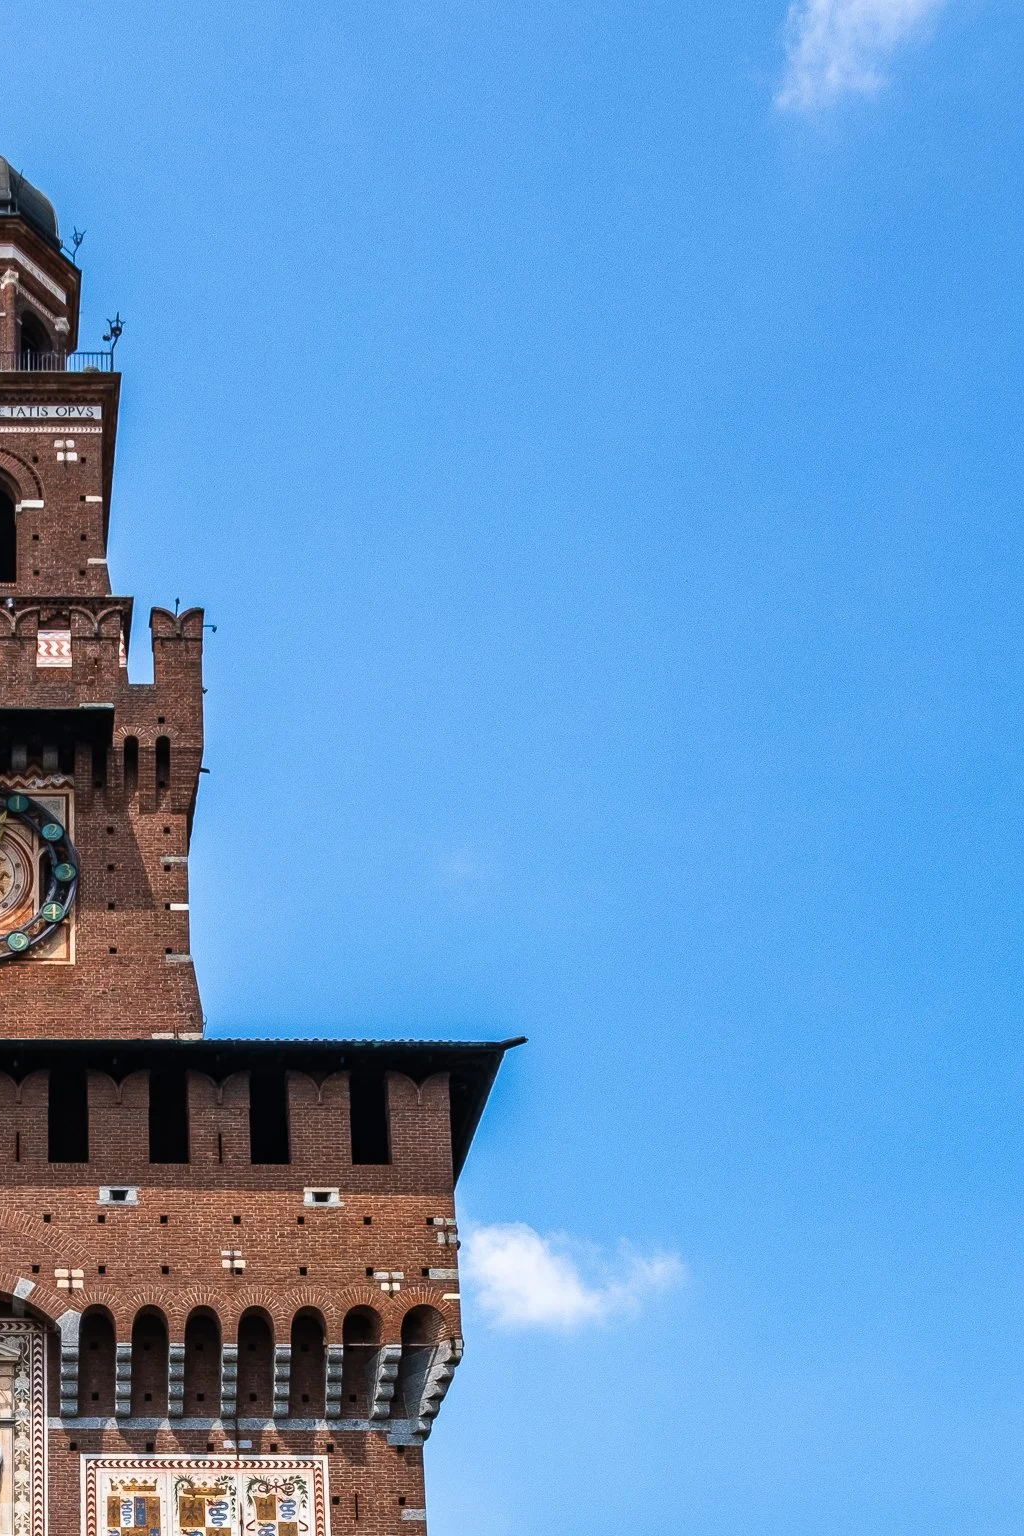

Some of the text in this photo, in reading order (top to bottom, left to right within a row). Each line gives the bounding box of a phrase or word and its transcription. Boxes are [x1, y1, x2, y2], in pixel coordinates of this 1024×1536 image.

[56, 406, 94, 417] OPVS
[47, 824, 58, 839] 2
[61, 864, 72, 878] 3
[43, 904, 59, 920] 4
[13, 934, 24, 949] 5
